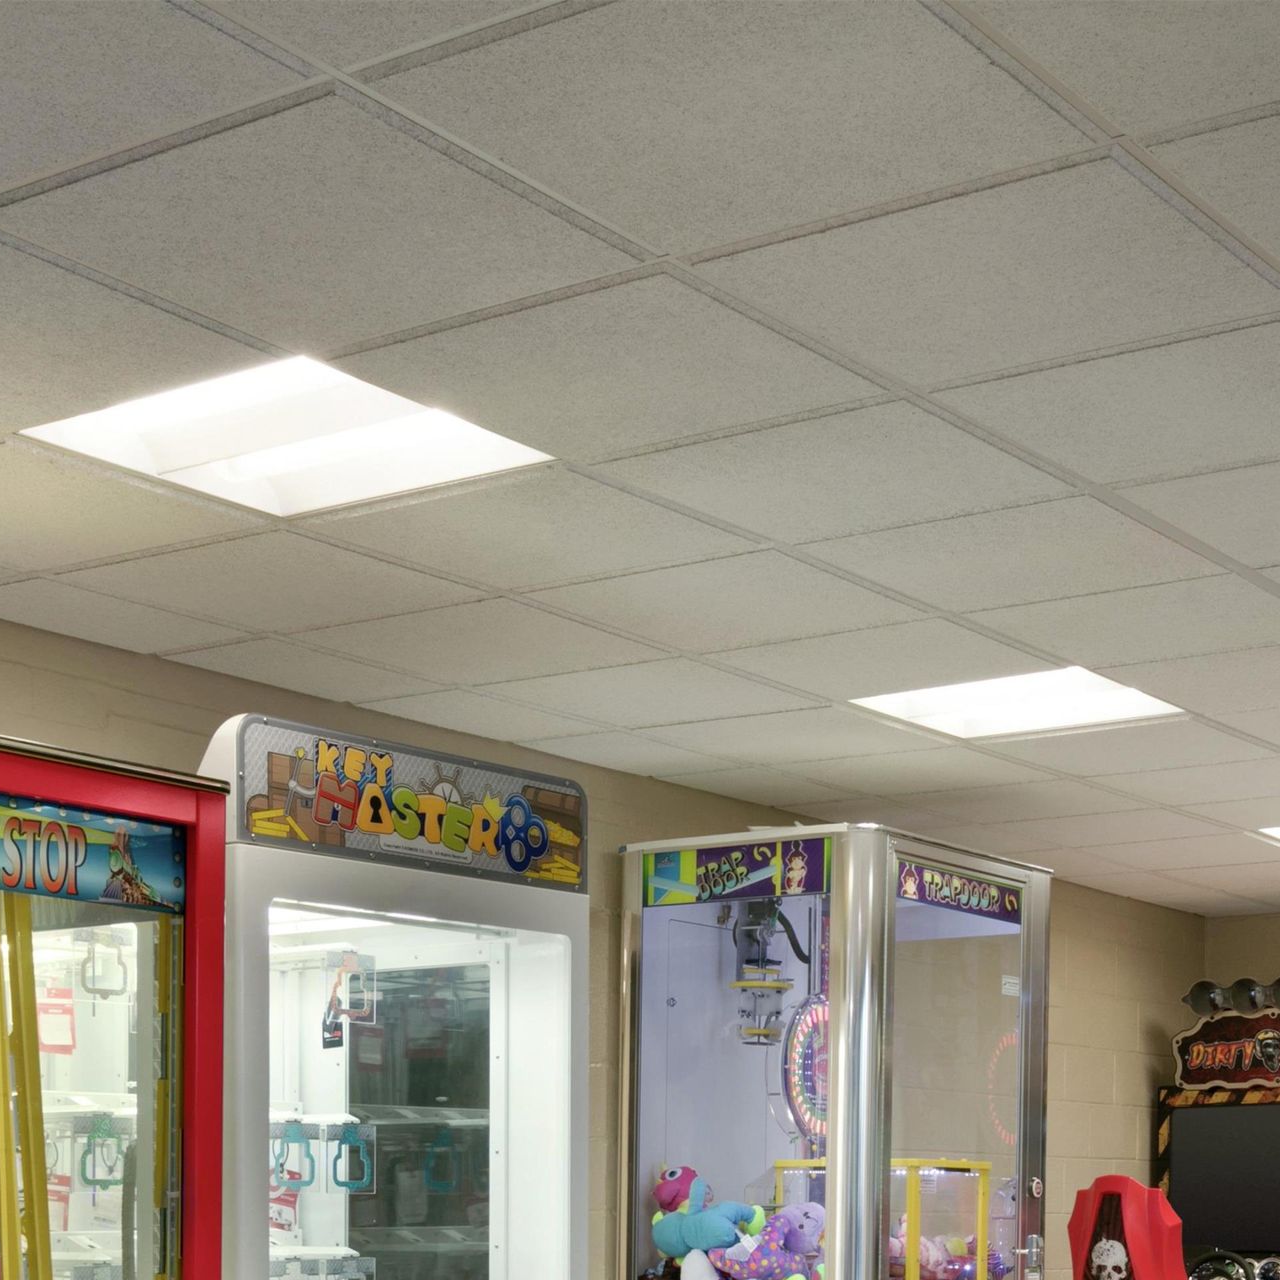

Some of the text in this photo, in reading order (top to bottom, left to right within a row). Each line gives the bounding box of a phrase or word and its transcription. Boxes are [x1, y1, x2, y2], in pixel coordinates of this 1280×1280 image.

[317, 739, 393, 787] KEY
[313, 772, 500, 858] MASTER
[697, 851, 743, 882] TRAP
[698, 865, 751, 901] DOOR
[1188, 1040, 1256, 1070] DIRTY
